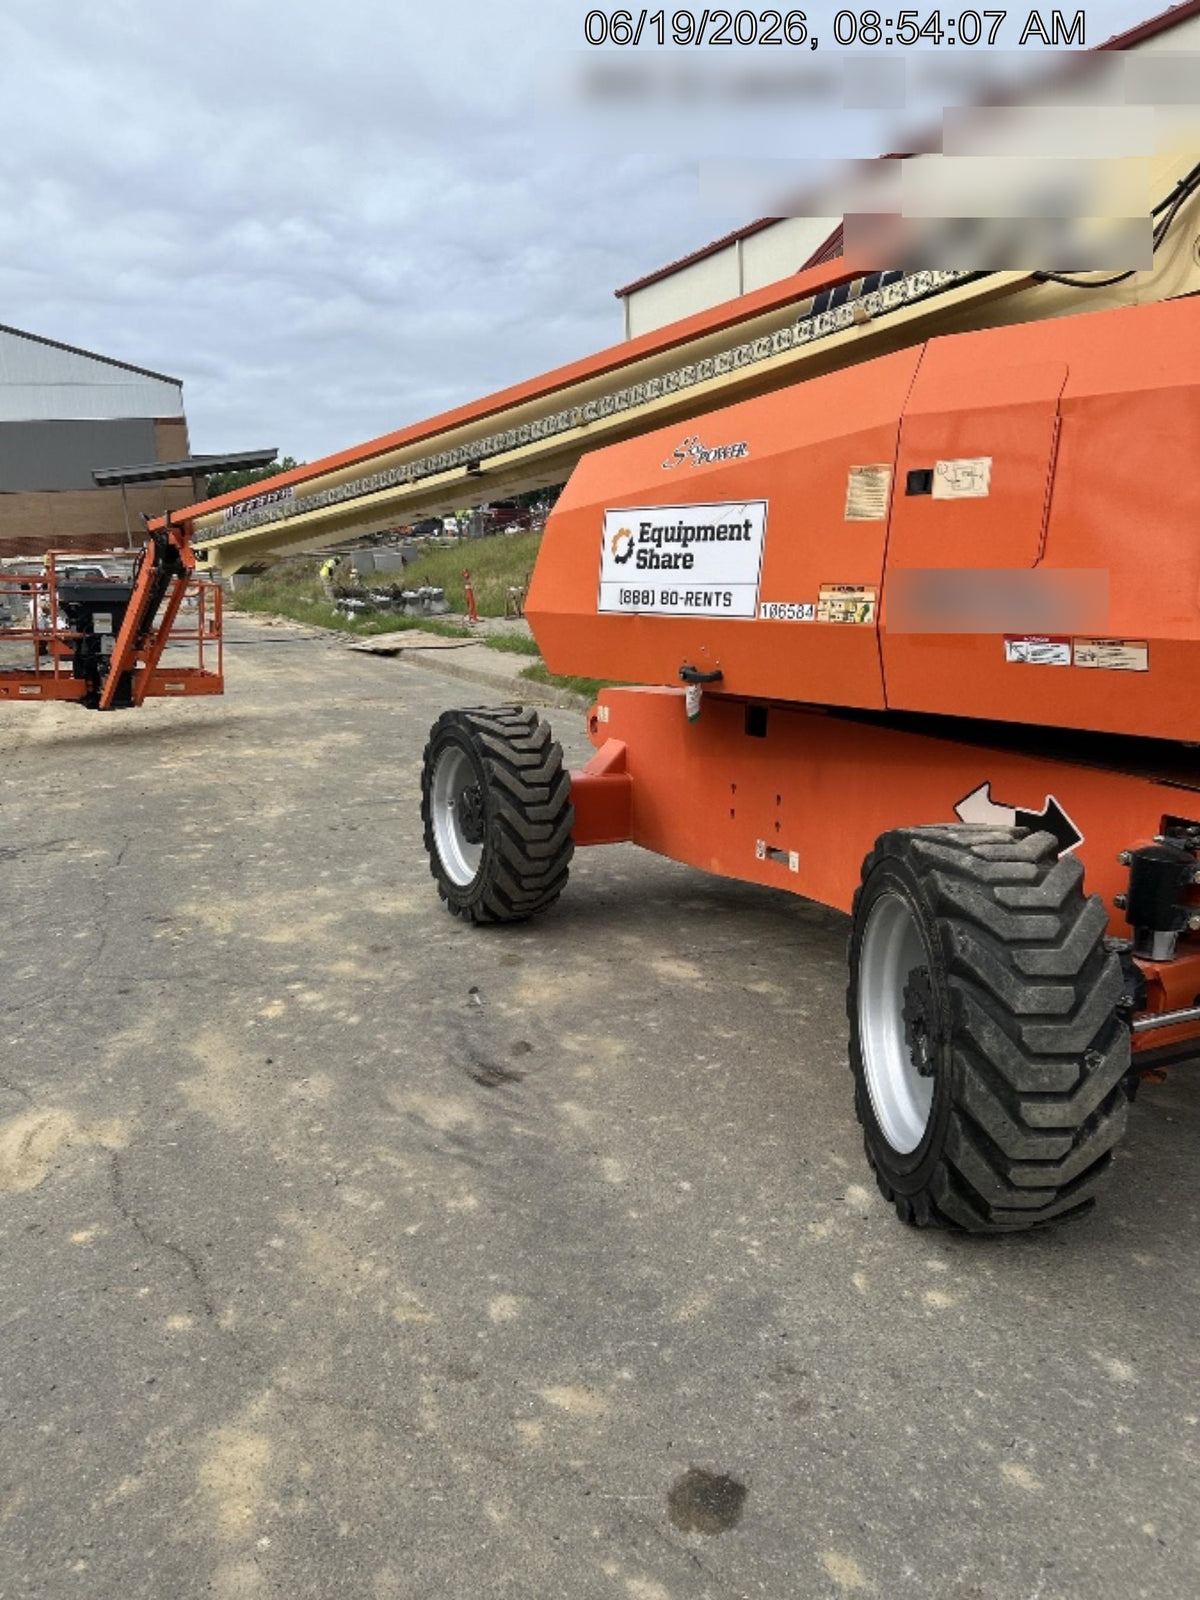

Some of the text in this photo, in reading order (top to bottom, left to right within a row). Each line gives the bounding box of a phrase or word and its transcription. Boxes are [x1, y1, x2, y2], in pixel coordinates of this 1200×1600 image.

[637, 519, 753, 548] Equipment
[635, 548, 695, 570] Share
[619, 588, 655, 607] (888)
